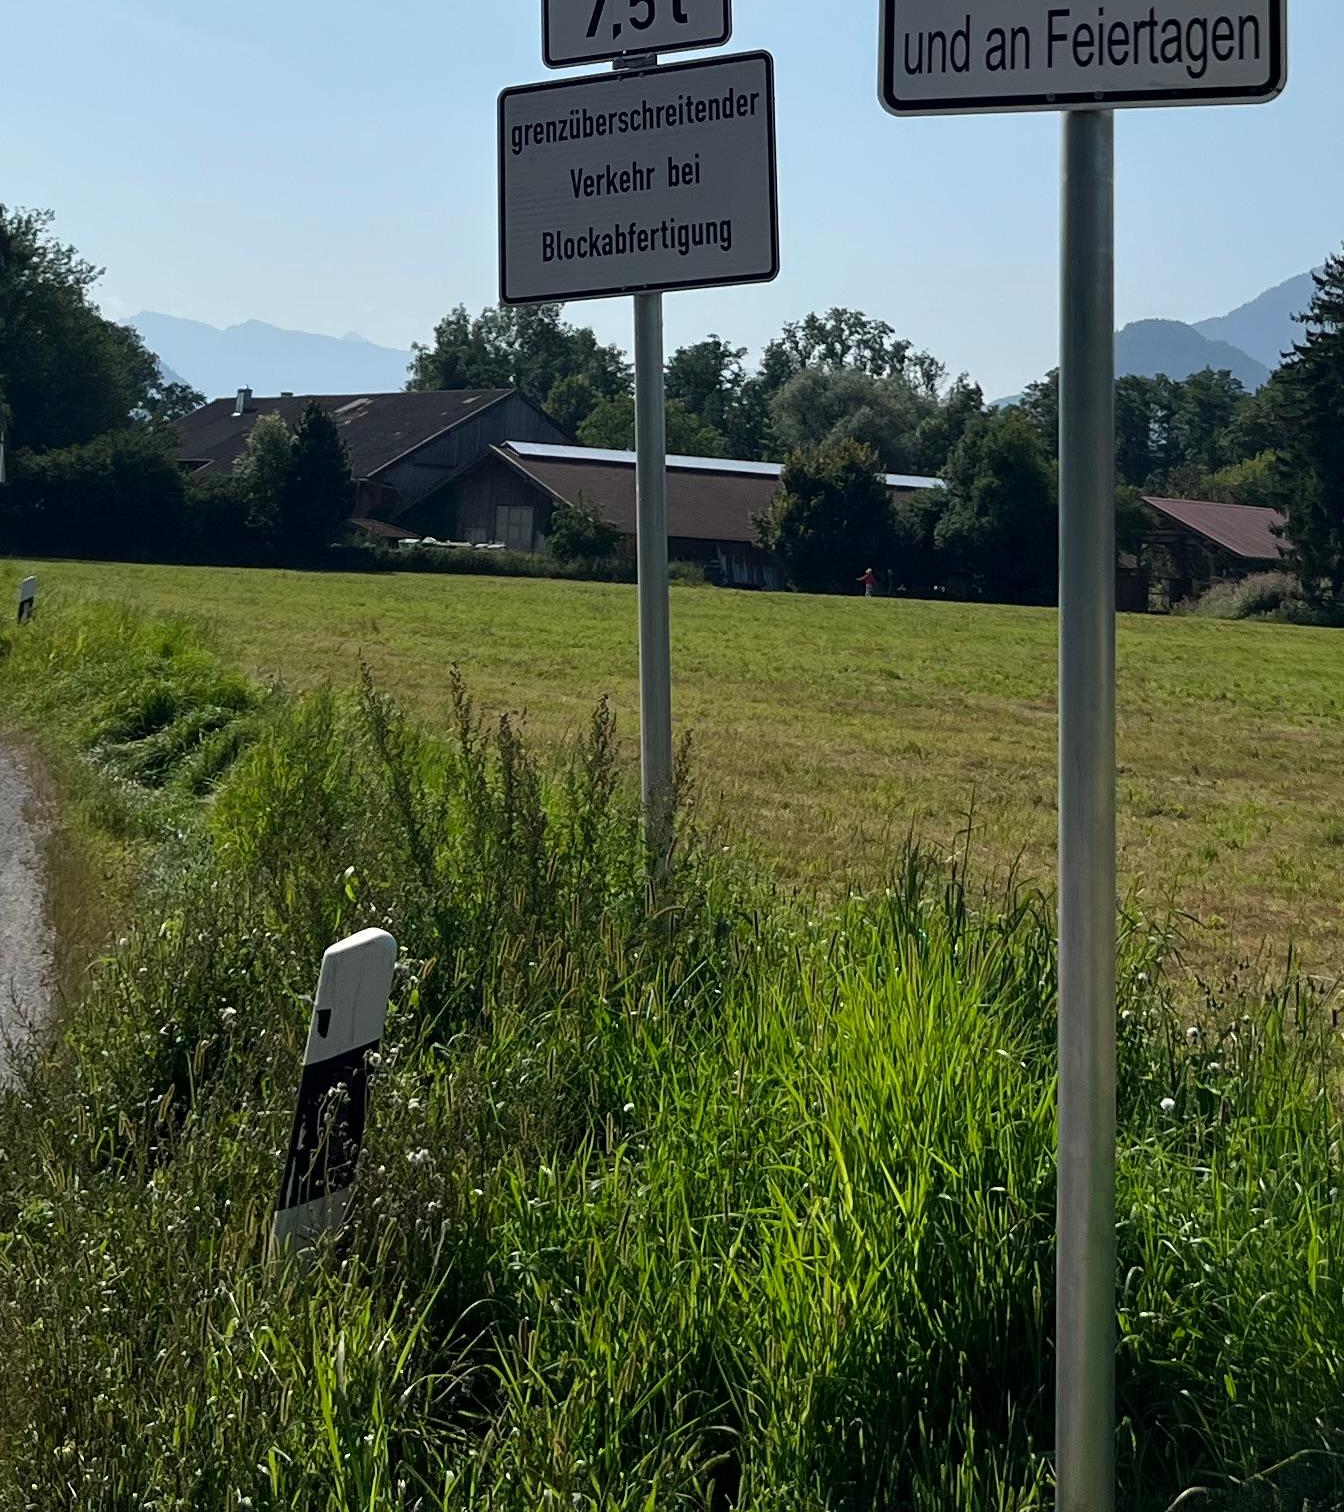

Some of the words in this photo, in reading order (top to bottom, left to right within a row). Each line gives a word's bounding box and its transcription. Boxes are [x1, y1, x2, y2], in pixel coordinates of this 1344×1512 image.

[903, 14, 971, 75] und
[985, 26, 1030, 72] an
[1047, 6, 1260, 79] Feiertagen
[511, 88, 759, 156] grenzüberschreitender
[569, 159, 655, 199] Verkehr
[667, 153, 701, 187] bei
[541, 217, 732, 264] Blockabfertigung
